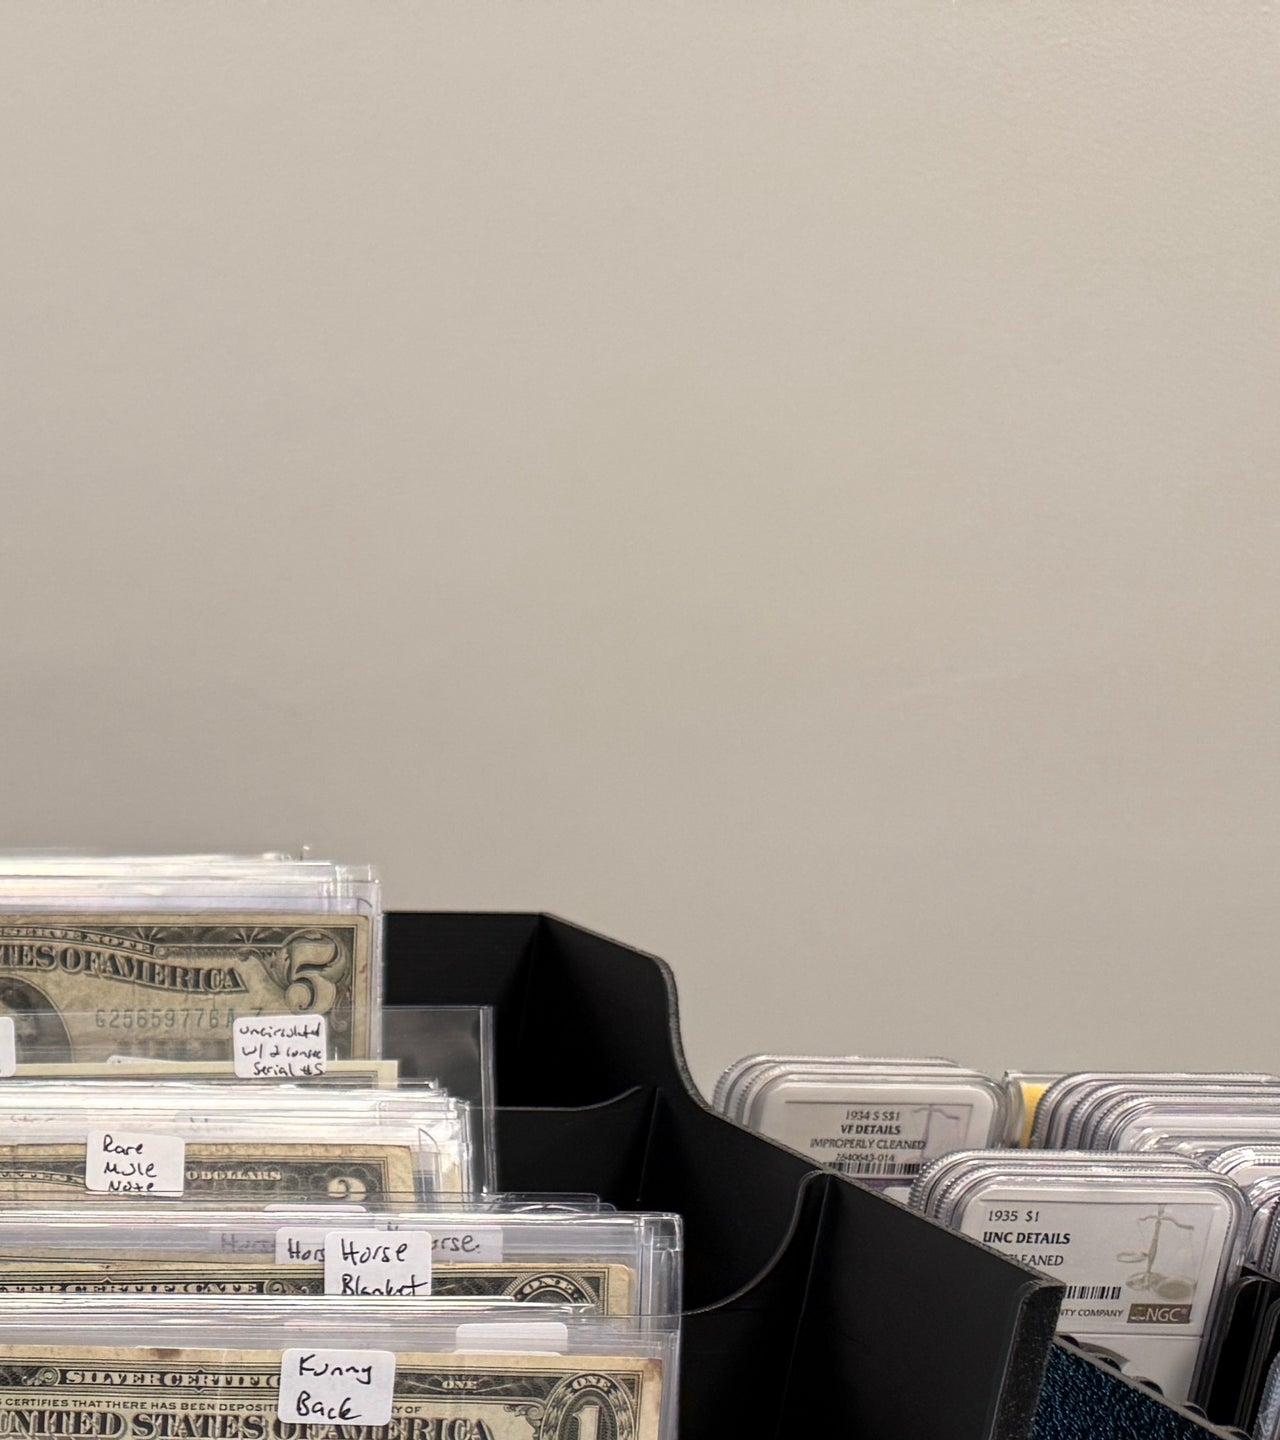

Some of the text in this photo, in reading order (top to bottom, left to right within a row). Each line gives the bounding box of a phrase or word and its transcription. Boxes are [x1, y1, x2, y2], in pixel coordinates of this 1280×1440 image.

[60, 946, 98, 973] OF
[98, 949, 248, 993] AMERICA
[286, 930, 339, 1012] 5
[846, 1110, 870, 1121] 1934
[840, 1124, 901, 1135] VF DETAILS
[102, 1134, 144, 1156] Rare
[810, 1138, 927, 1149] IMPROPERLY CLEANED
[988, 1210, 1040, 1222] 1935 $1
[983, 1231, 1071, 1245] UNC DETAILS
[341, 1238, 408, 1265] Horse
[341, 1274, 428, 1296] Blanket
[1078, 1308, 1123, 1317] COMPANY
[1146, 1308, 1181, 1321] NGC
[65, 1371, 156, 1385] SILVER
[571, 1376, 611, 1391] ONE
[441, 1380, 479, 1391] ONE
[5, 1398, 69, 1407] CERTIFIES
[72, 1399, 105, 1408] THAT
[106, 1400, 148, 1409] THERE
[151, 1402, 177, 1410] HAS
[181, 1403, 215, 1411] BEEN
[296, 1390, 362, 1420] Back
